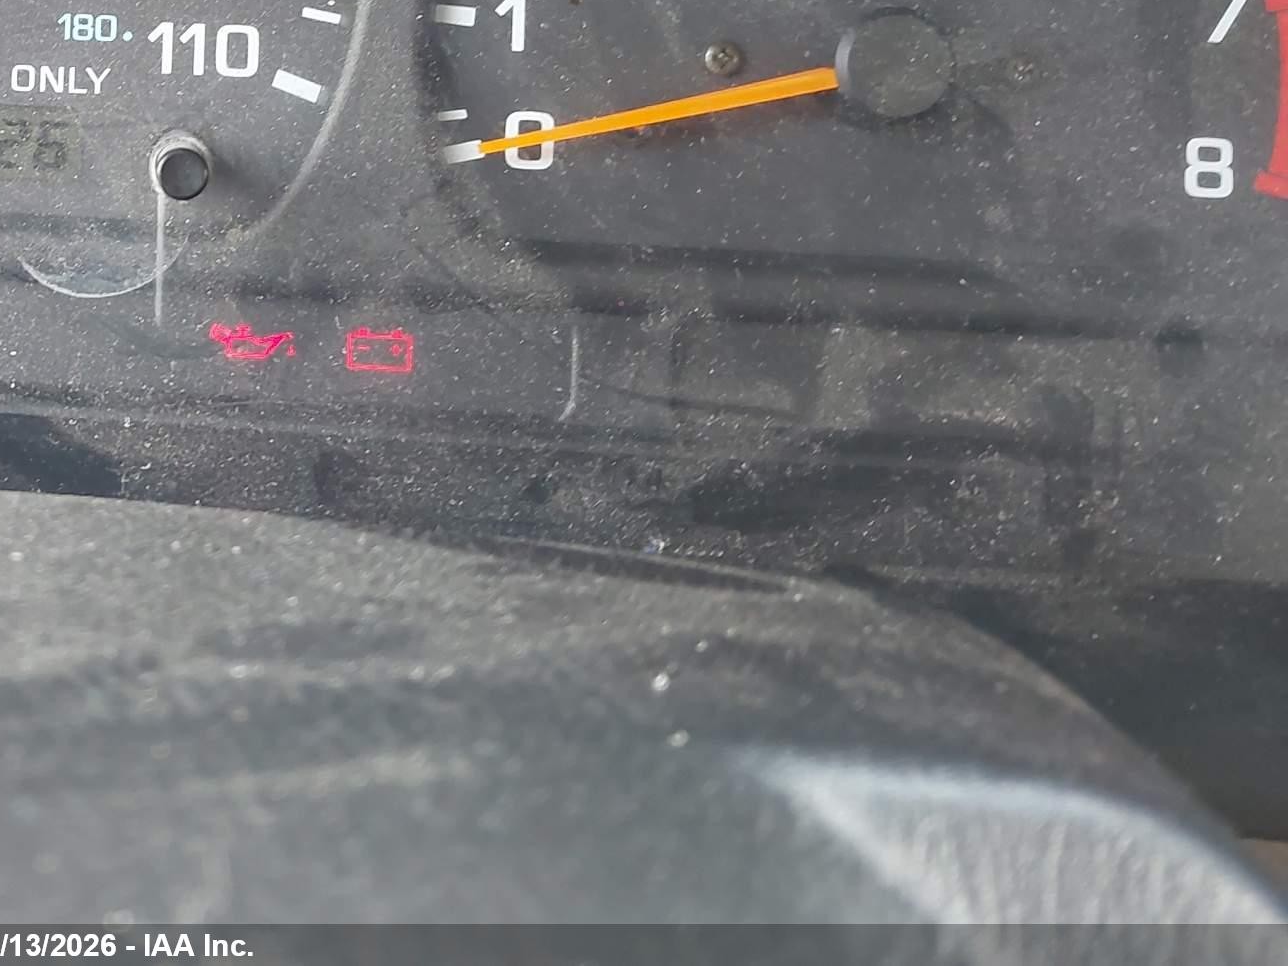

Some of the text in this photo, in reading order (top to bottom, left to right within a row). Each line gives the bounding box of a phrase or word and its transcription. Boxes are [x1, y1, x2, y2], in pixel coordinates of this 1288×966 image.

[57, 13, 118, 42] 180
[147, 21, 260, 78] 110
[10, 64, 112, 95] ONLY
[504, 110, 555, 171] 0
[1184, 137, 1234, 198] 8
